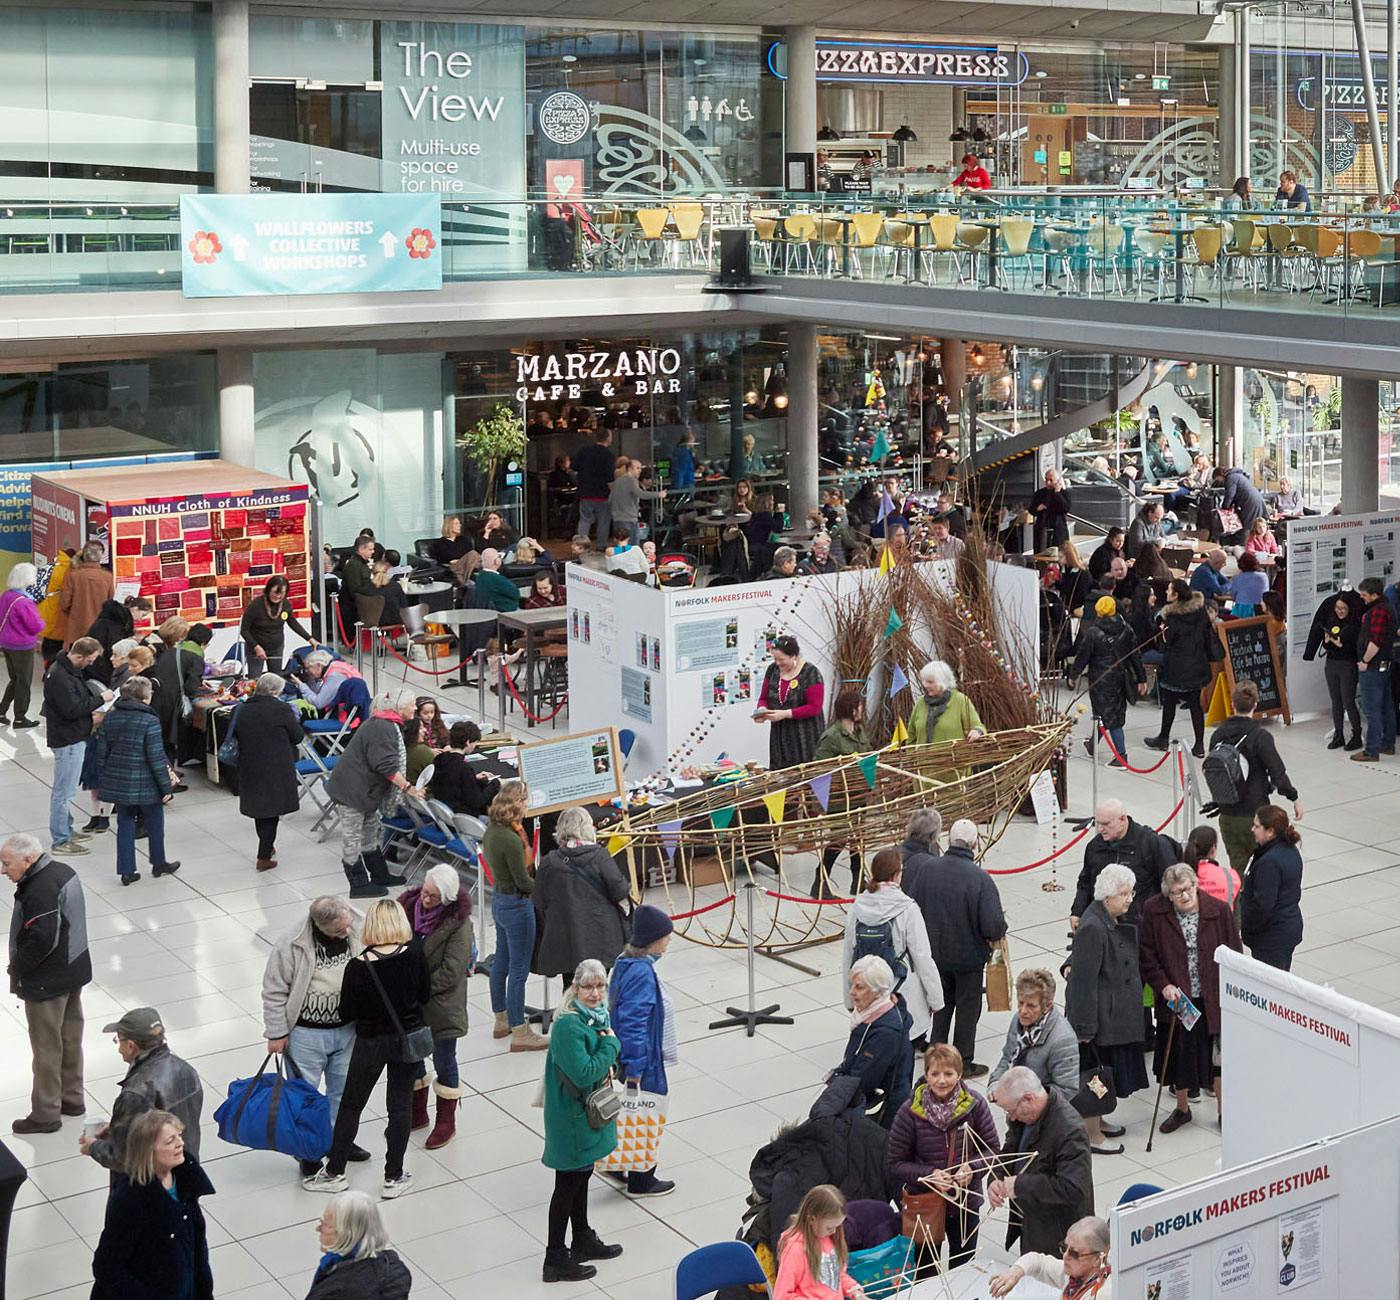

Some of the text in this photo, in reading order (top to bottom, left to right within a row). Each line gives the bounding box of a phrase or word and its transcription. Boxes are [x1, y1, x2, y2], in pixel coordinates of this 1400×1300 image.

[398, 42, 472, 78] The
[816, 50, 1009, 77] IZZAEXPRESS
[399, 85, 504, 122] View
[545, 116, 584, 124] EXPRESS
[400, 139, 481, 156] Multi-use
[400, 161, 459, 177] space
[401, 177, 464, 192] for hire
[255, 221, 374, 237] WALLFLOWERS
[270, 238, 360, 253] COLLECTIVE
[262, 254, 367, 272] WORKSHOPS
[516, 349, 681, 382] MARZANO
[516, 379, 681, 401] CAFE & BAR
[0, 470, 32, 480] Citize
[0, 483, 32, 494] Advic
[132, 493, 291, 516] NNUH Cloth of Kindness
[675, 590, 772, 607] NORFOLK MAKERS FESTIVAL
[1226, 983, 1351, 1047] NORFOLK MAKERS FESTIVAL
[1130, 1208, 1203, 1247] NORFOLK
[1206, 1186, 1266, 1220] MAKERS
[1269, 1164, 1331, 1199] FESTIVAL
